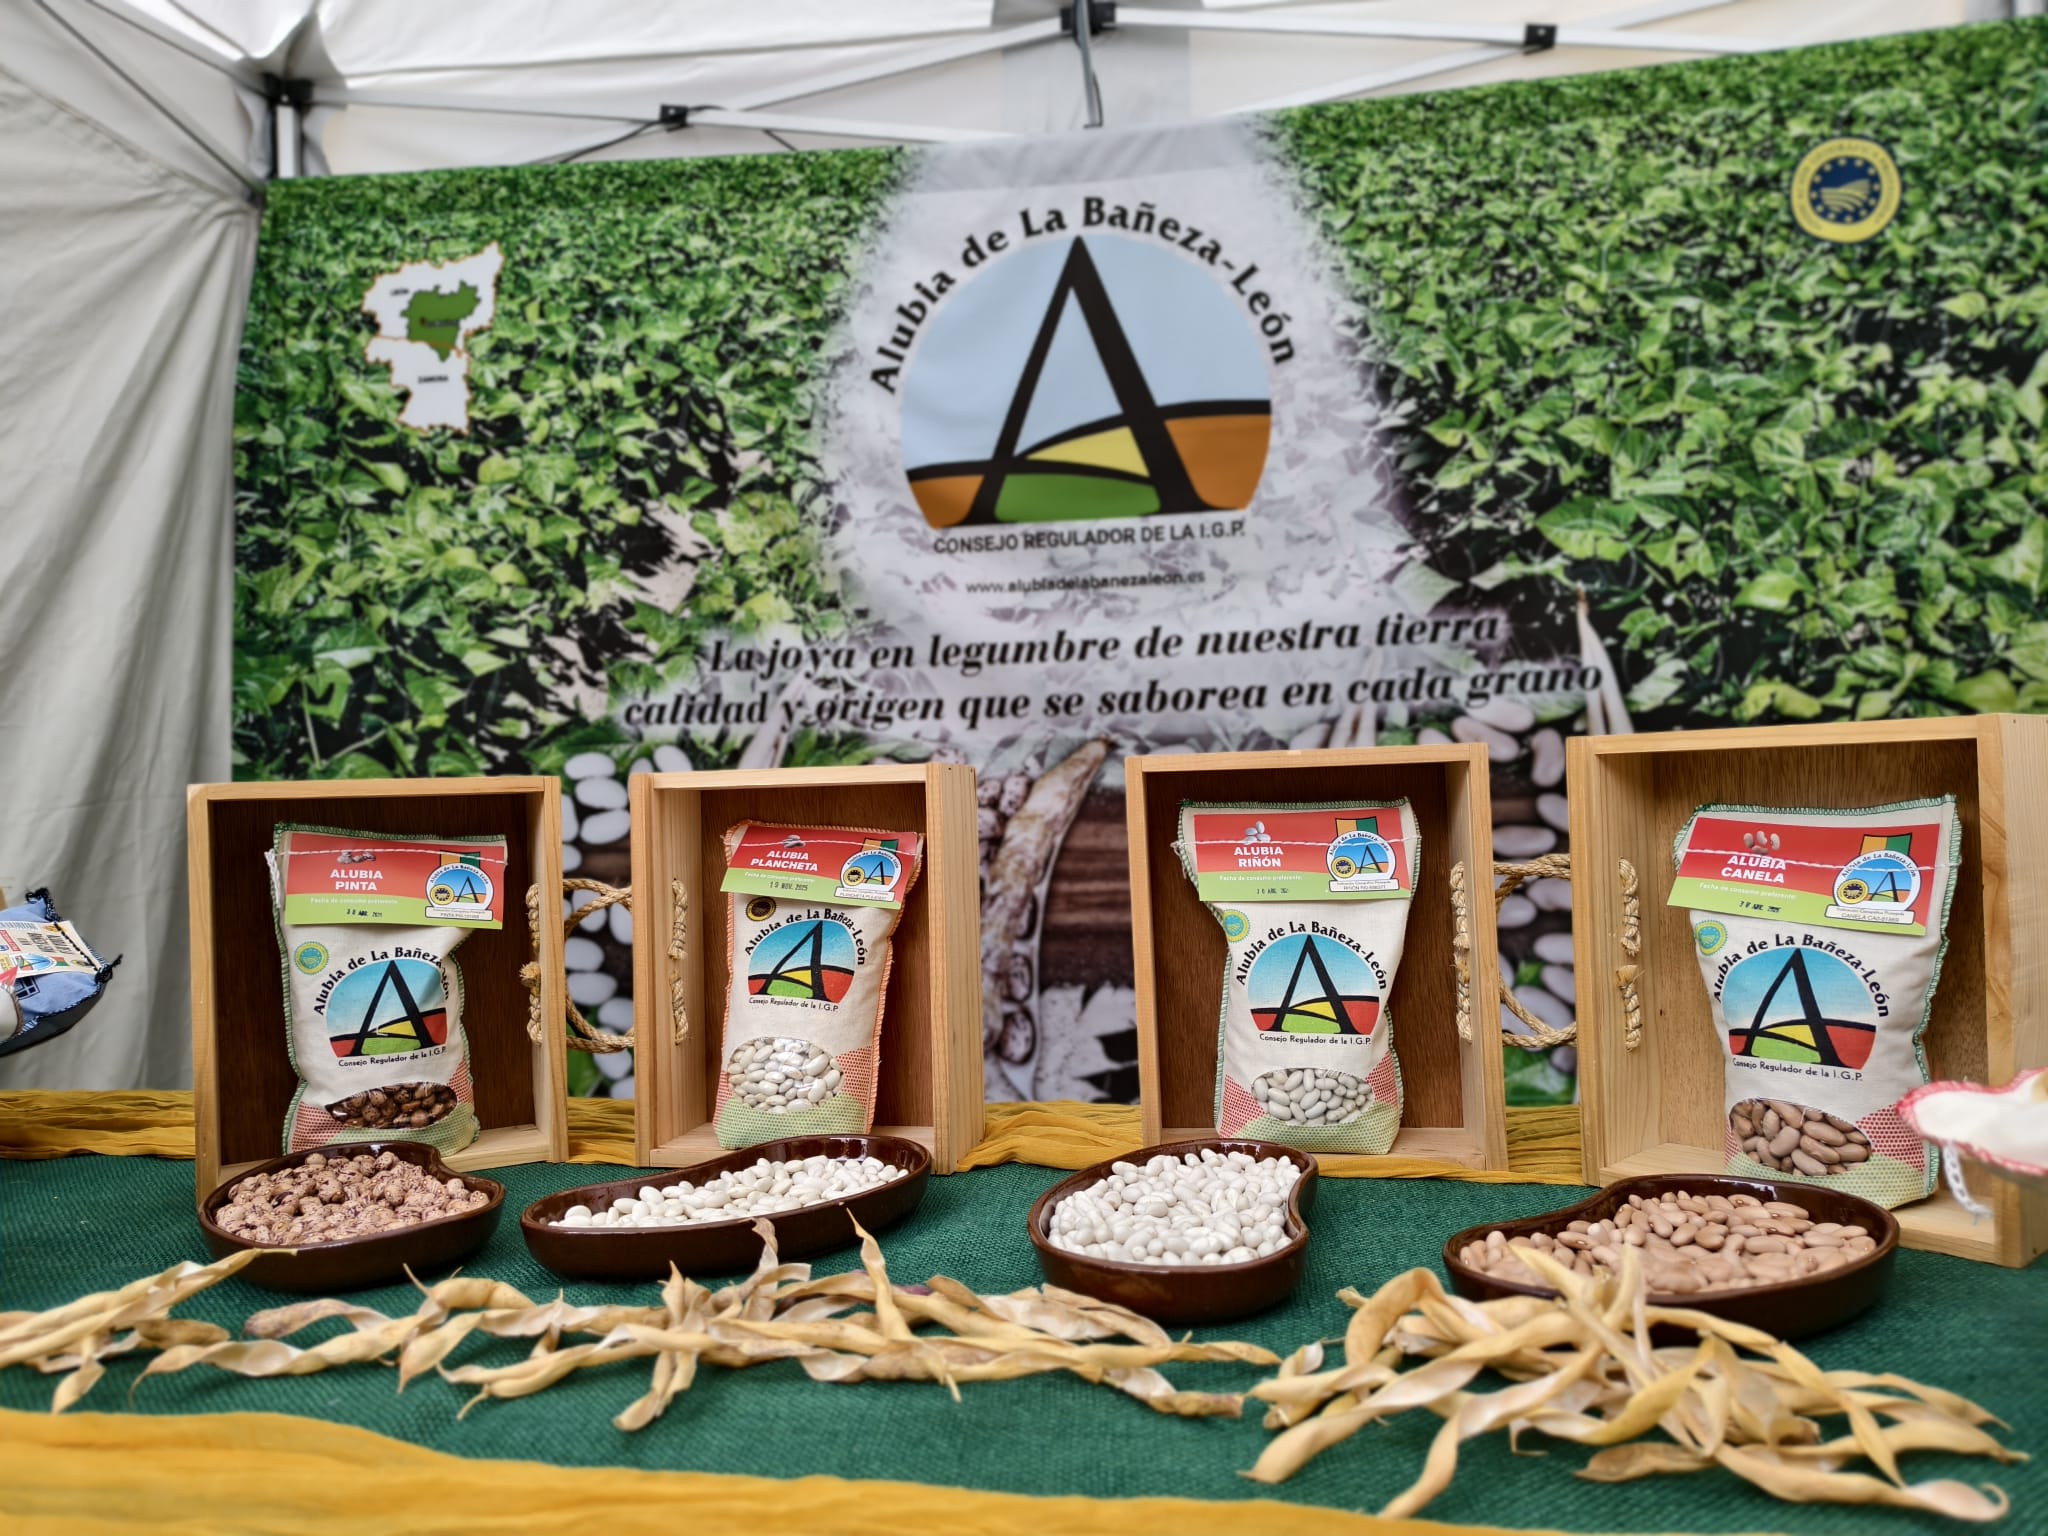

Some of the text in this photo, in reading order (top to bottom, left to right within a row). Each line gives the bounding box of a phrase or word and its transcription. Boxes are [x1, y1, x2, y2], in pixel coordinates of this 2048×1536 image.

[870, 197, 1298, 393] Alubia de La Bañeza-León
[934, 520, 1246, 554] CONSEJO REGULADOR DE LA I.G.P.
[712, 612, 1501, 680] La joya en legumbre de nuestra tierra
[624, 665, 1604, 734] calidad y origen que se saborea en cada grano
[767, 850, 809, 860] ALUBIA
[1234, 846, 1283, 856] ALUBIA
[750, 858, 818, 872] PLANCHETA
[1238, 856, 1281, 868] RIÑÓN
[1727, 854, 1787, 870] ALUBIA
[330, 868, 384, 881] ALUBIA
[1721, 866, 1785, 884] CANELA
[335, 881, 378, 892] PINTA
[745, 921, 782, 955] Alubia
[786, 914, 802, 924] de
[807, 908, 819, 919] La
[1236, 921, 1387, 990] Alubia de La Bañeza-León
[314, 968, 346, 1016] Alubia
[348, 956, 367, 970] de
[371, 949, 389, 961] La
[1713, 933, 1890, 1018] Alubia de La Bañeza-León
[1259, 1033, 1287, 1043] Consejo
[1290, 1035, 1326, 1044] Regulador
[1329, 1036, 1338, 1044] de
[338, 1058, 368, 1067] Consejo
[370, 1054, 407, 1065] Regulador
[410, 1052, 419, 1060] de
[1760, 1060, 1803, 1074] Regulador
[1805, 1066, 1818, 1077] de
[1821, 1068, 1830, 1078] la
